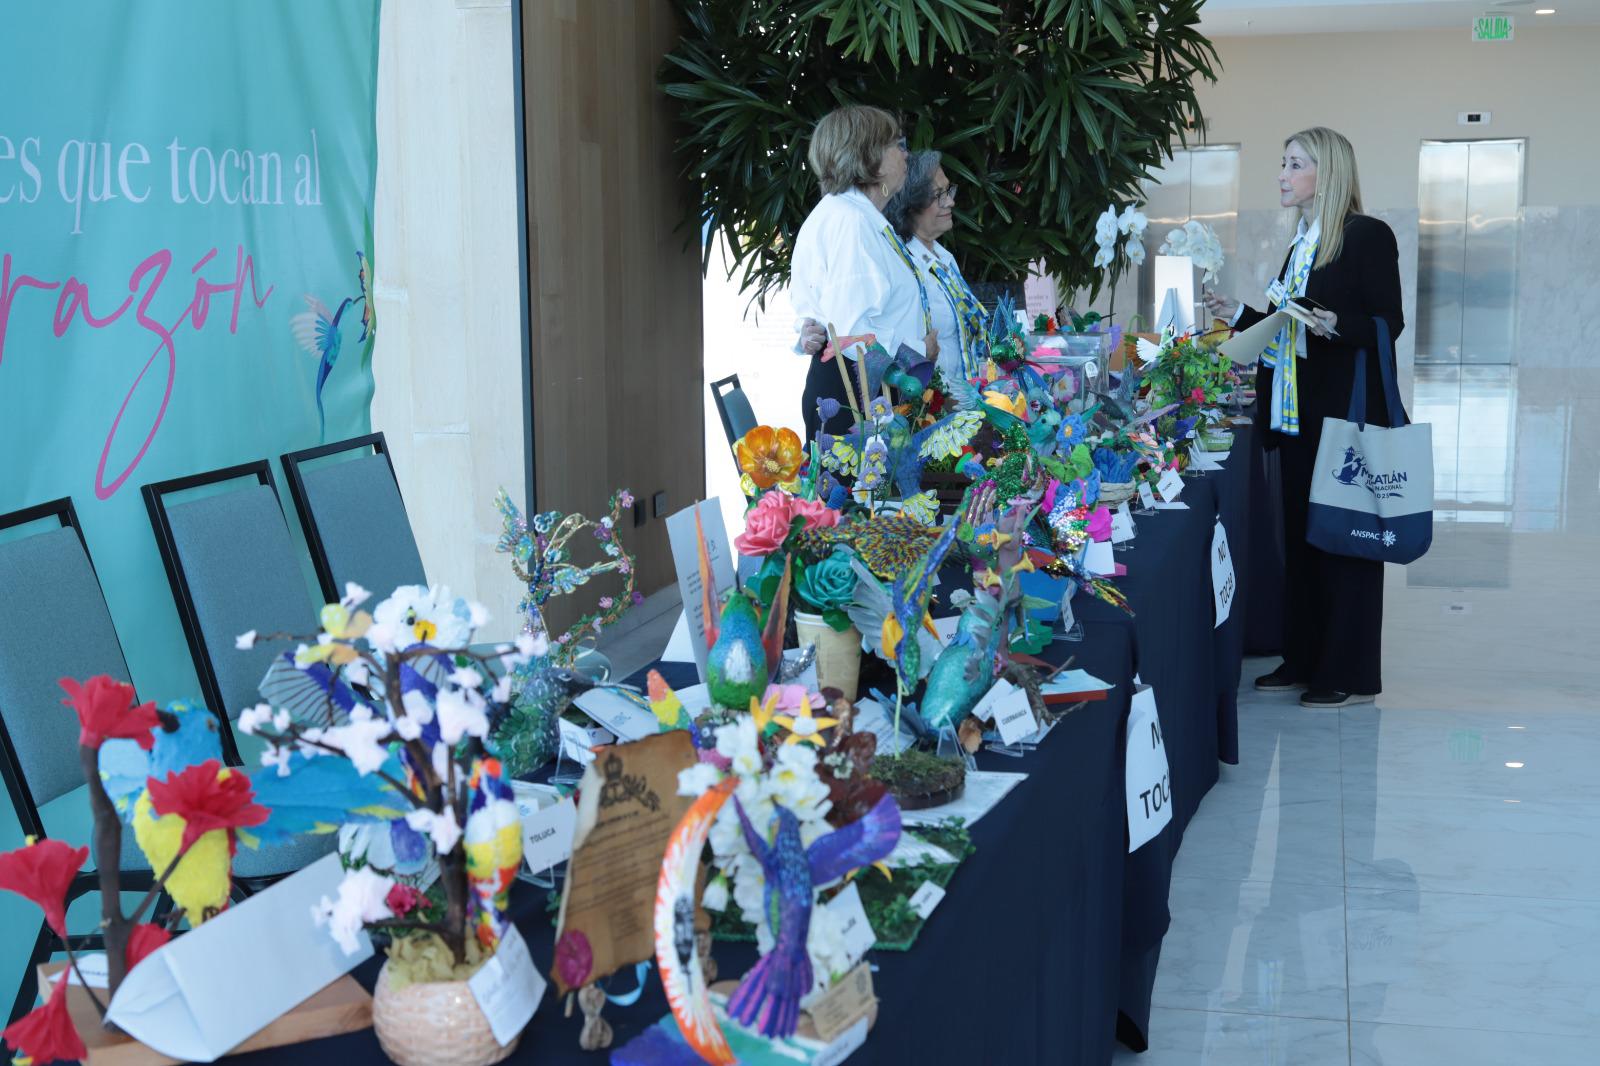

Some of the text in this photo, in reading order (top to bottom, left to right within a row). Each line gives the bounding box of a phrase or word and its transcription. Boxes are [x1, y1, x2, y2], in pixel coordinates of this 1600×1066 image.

[57, 136, 152, 234] que
[166, 135, 285, 205] tocan
[294, 128, 324, 206] al
[1361, 466, 1408, 485] MATLÁN
[1351, 529, 1381, 541] ANSPAC
[1217, 540, 1226, 565] NO
[529, 827, 556, 844] TOLUCA
